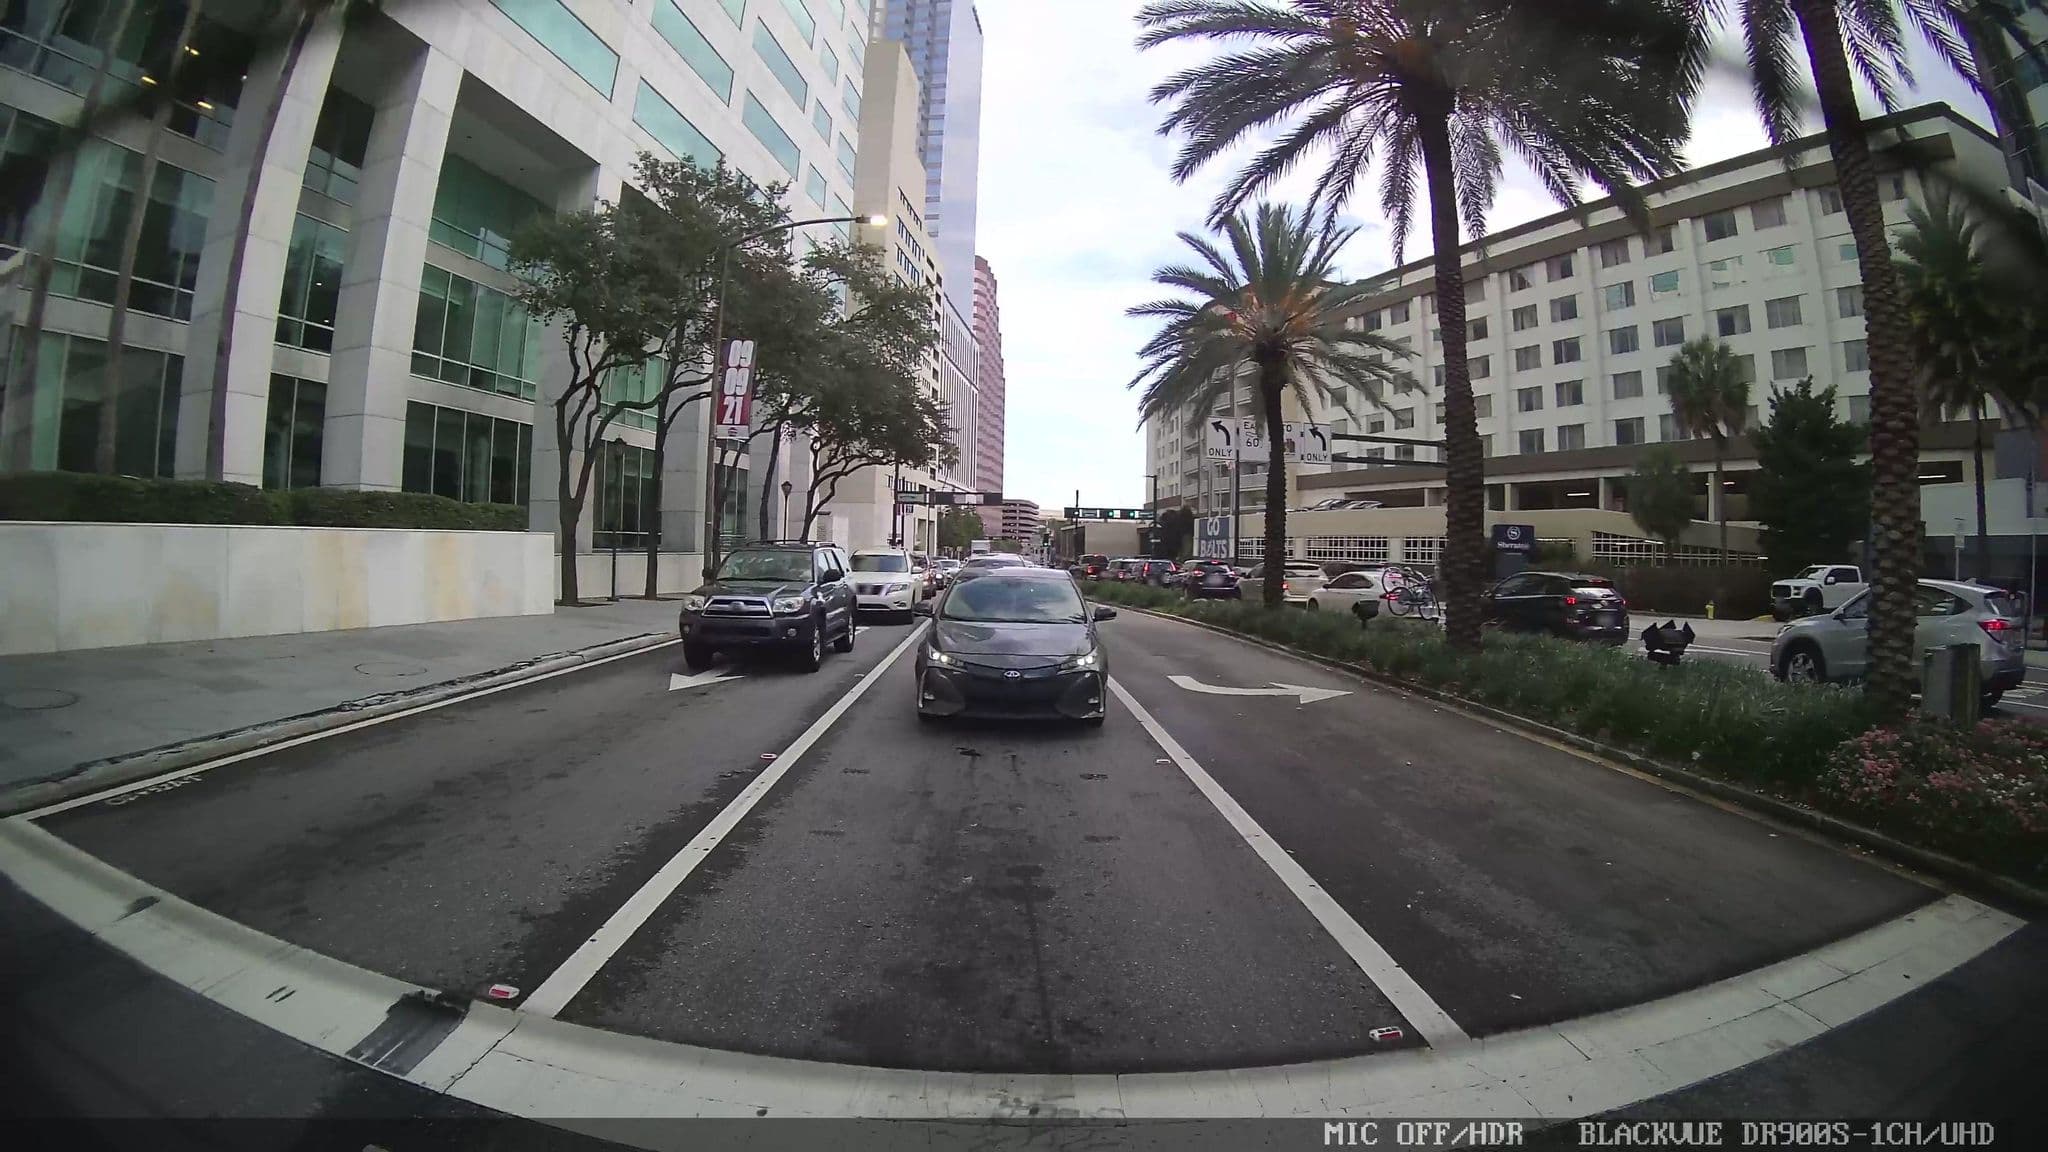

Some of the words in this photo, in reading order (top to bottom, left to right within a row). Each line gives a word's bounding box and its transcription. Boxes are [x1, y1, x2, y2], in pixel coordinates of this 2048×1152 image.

[722, 396, 744, 424] 21
[1208, 448, 1232, 456] ONLY
[1306, 453, 1328, 461] ONLY
[1207, 519, 1220, 536] GO
